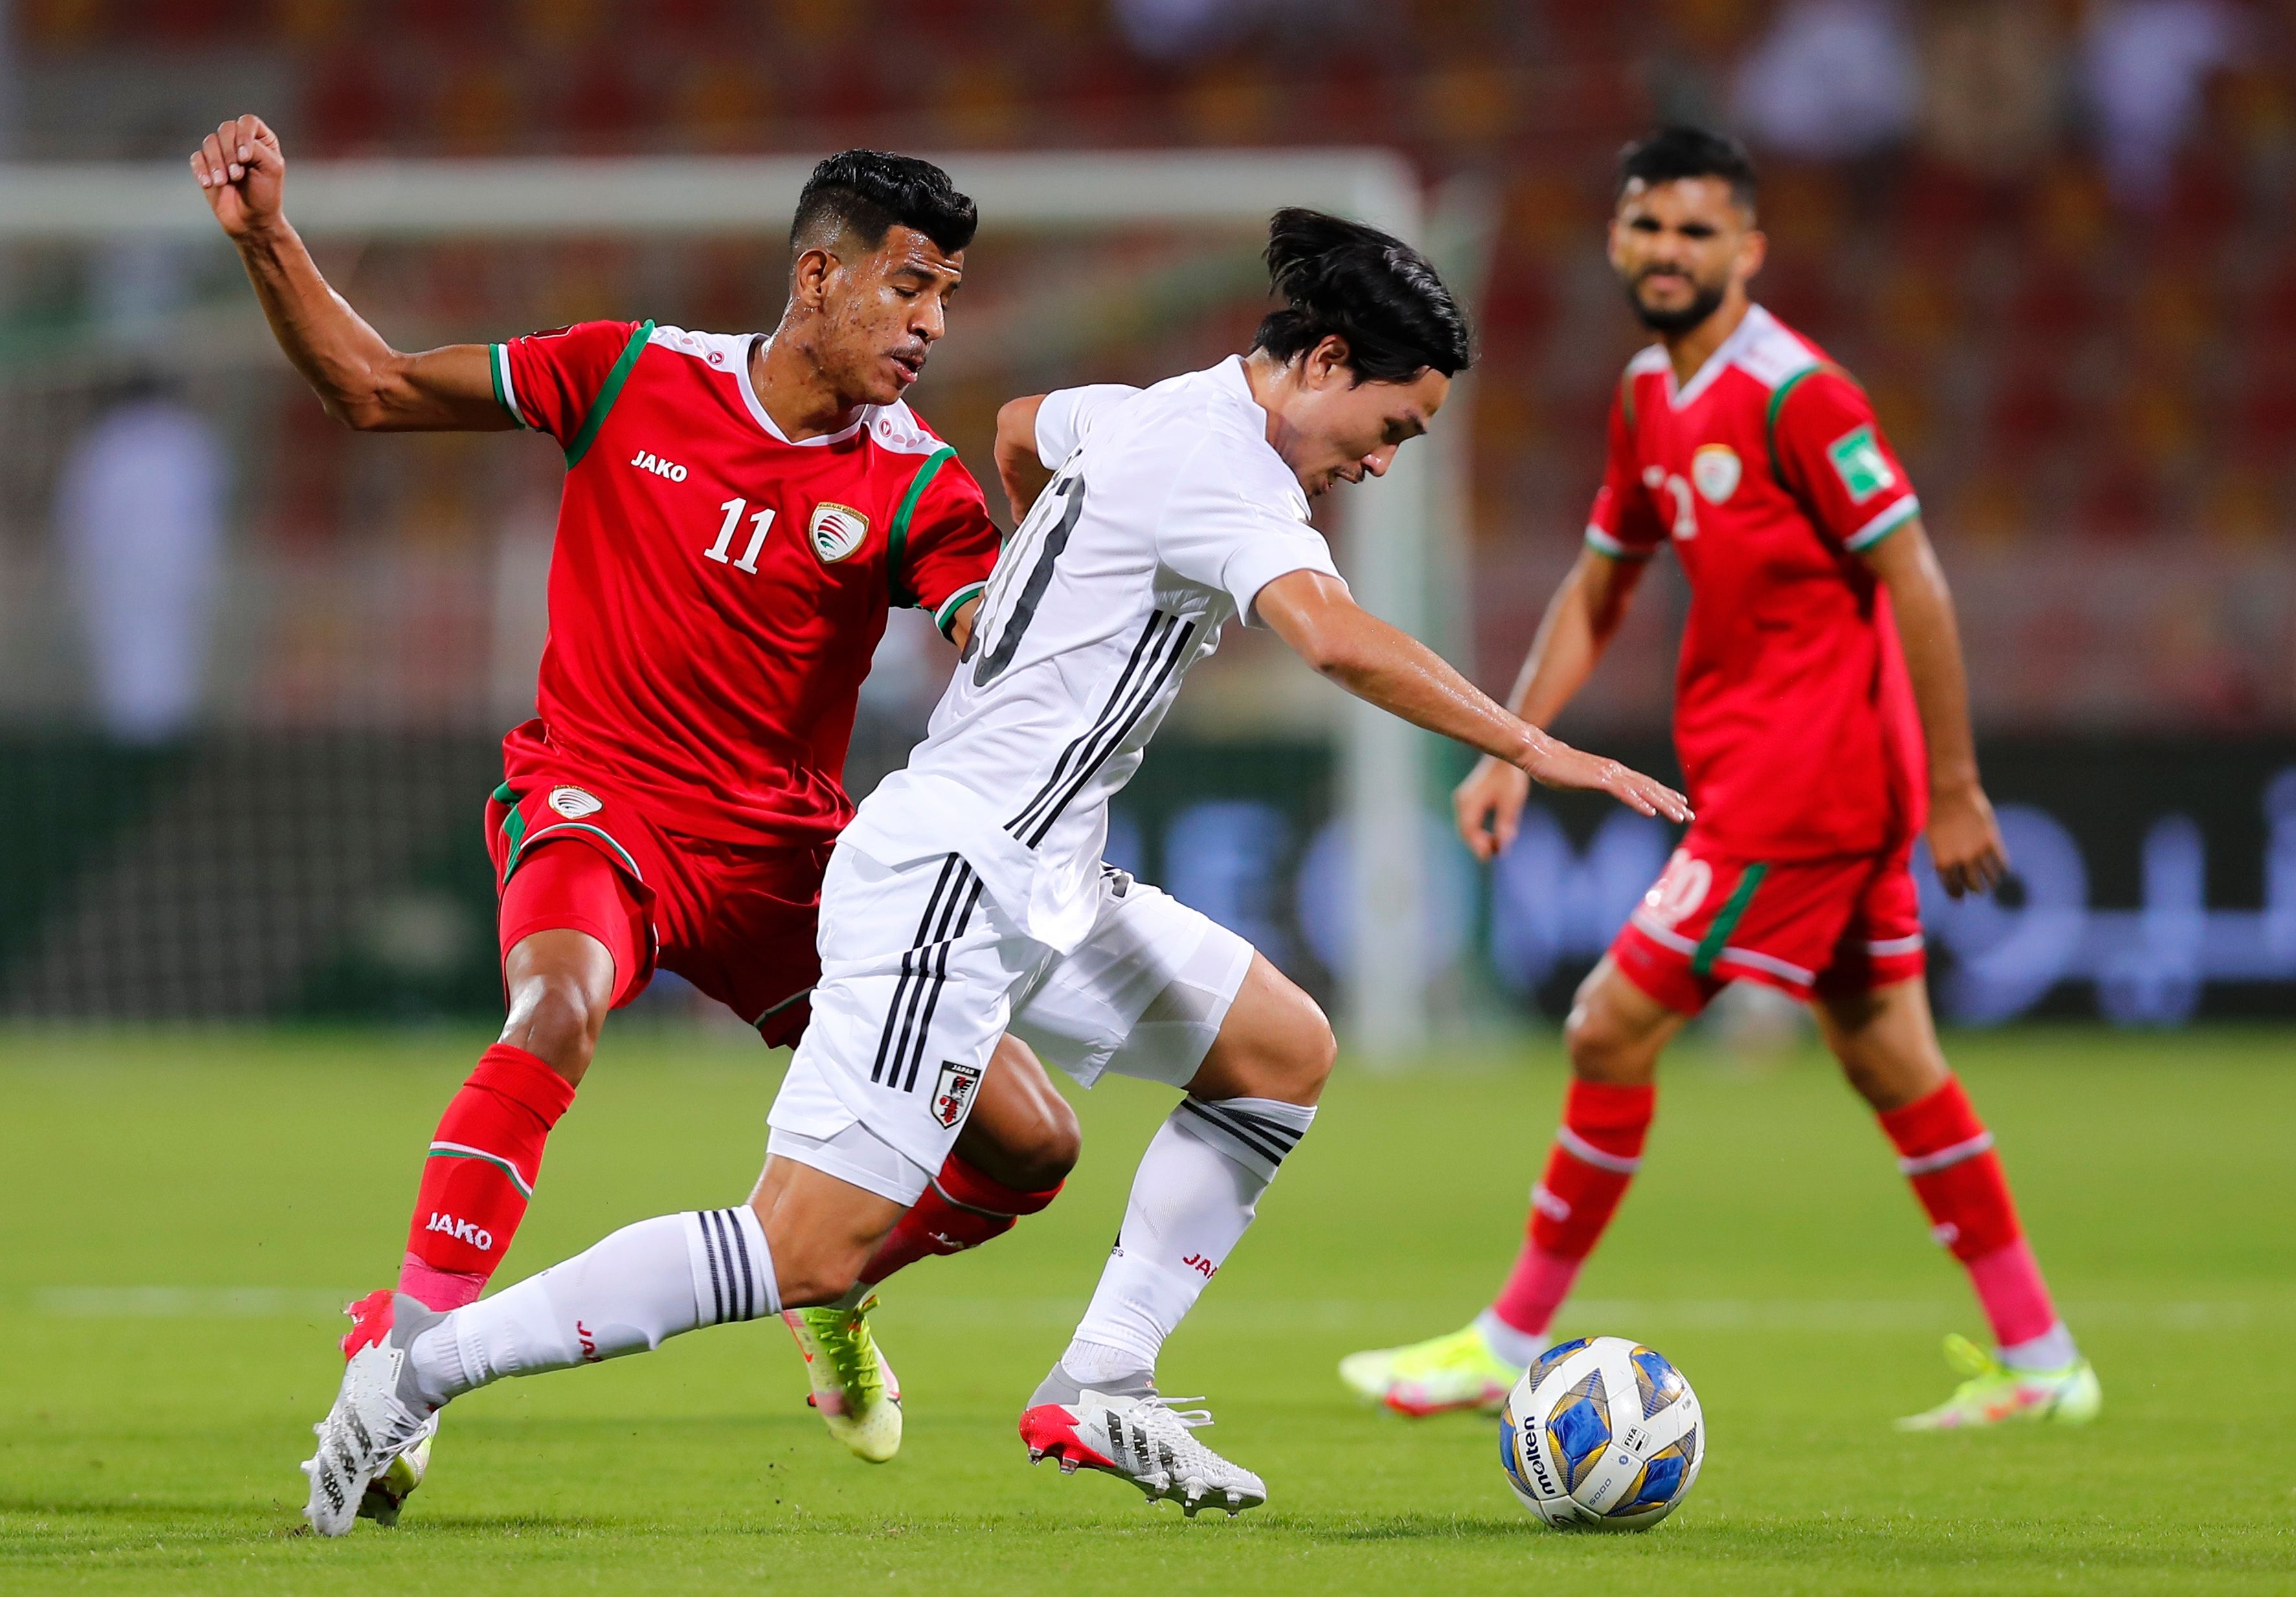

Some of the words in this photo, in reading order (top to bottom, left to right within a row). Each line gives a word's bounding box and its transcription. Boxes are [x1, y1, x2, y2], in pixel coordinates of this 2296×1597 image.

[631, 450, 688, 482] JAKO
[703, 497, 776, 575] 11
[951, 1064, 975, 1075] JAPAN
[425, 1211, 493, 1251] JAKO
[1624, 1428, 1638, 1446] FIFA
[1524, 1416, 1556, 1495] molten
